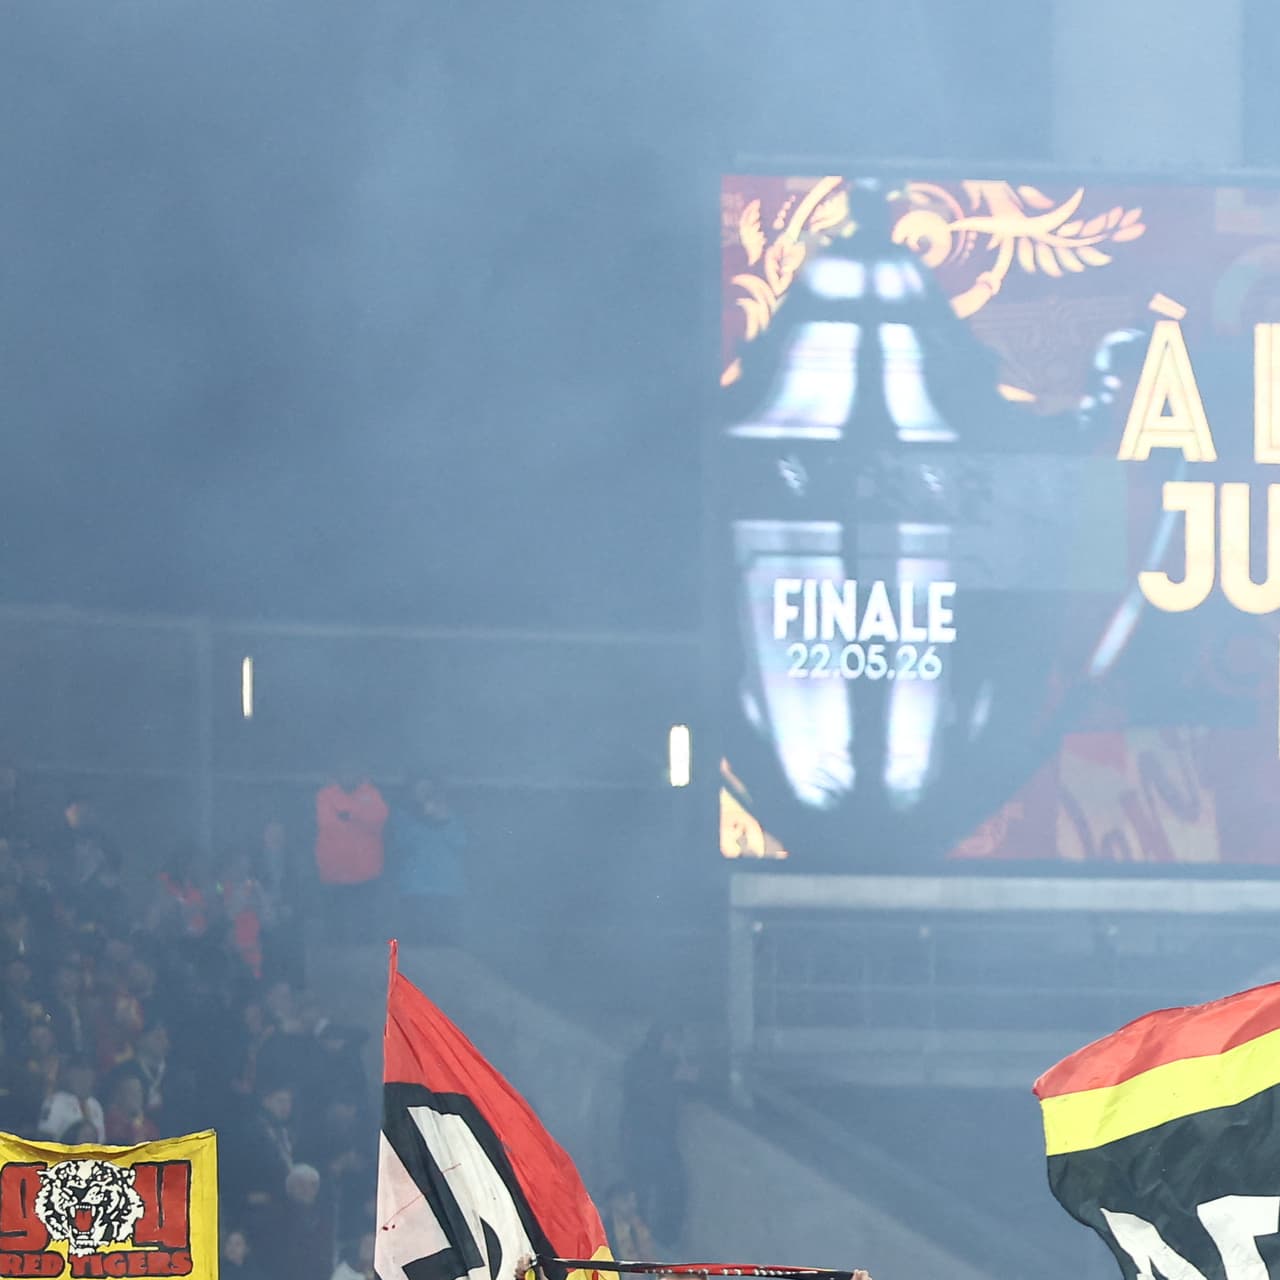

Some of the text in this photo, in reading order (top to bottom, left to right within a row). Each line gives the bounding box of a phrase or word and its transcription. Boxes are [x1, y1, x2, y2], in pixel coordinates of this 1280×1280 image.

[1117, 293, 1218, 463] À
[773, 577, 958, 643] FINALE
[786, 643, 943, 681] 22.05.26
[0, 1251, 193, 1277] RED TIGERS
